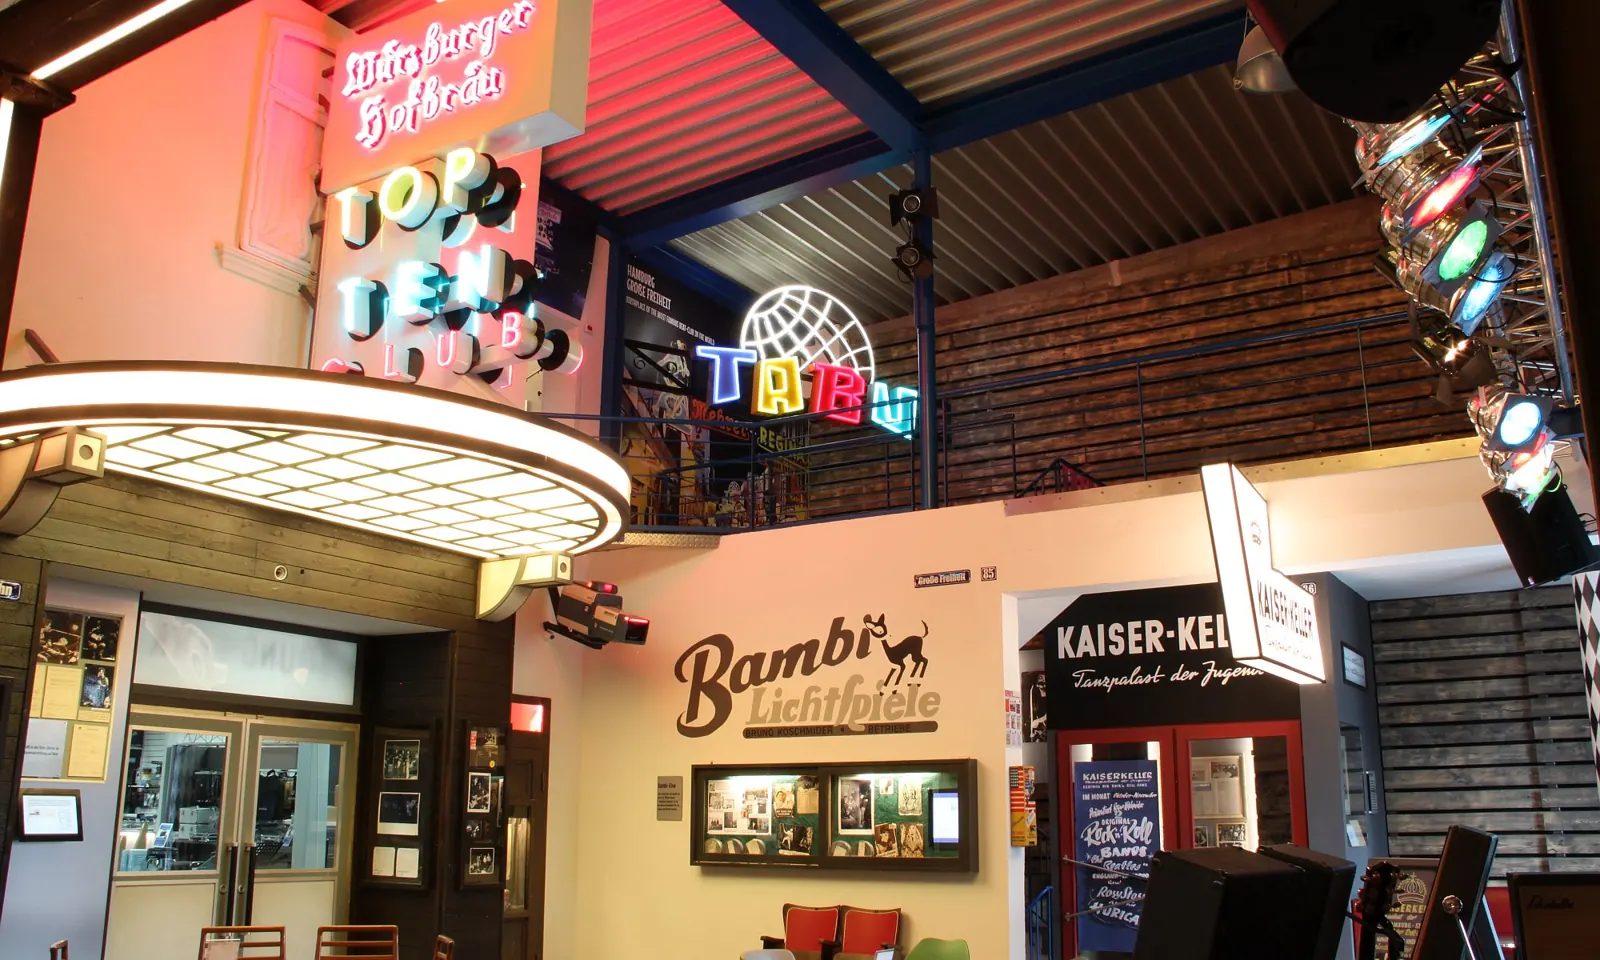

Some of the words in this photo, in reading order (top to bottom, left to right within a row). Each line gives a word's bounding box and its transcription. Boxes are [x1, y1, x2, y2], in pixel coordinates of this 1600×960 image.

[335, 146, 478, 247] TOP
[627, 264, 656, 289] HAMBURG
[337, 244, 494, 342] TEN
[646, 288, 672, 311] FREIHEIT
[695, 345, 919, 440] TABU
[939, 572, 966, 584] Freiheit
[982, 568, 995, 580] 85
[1257, 579, 1314, 642] KAISER-KELLER
[1057, 614, 1229, 660] KAISER-KEL
[674, 616, 872, 738] Bambi
[1072, 665, 1165, 693] Tanzpalast
[1170, 663, 1199, 683] der
[746, 726, 774, 737] BRUNO
[777, 724, 834, 737] KOSCHMIDER
[868, 723, 911, 734] BETRIEBE
[1082, 771, 1153, 781] KAISERKELLER
[1101, 817, 1131, 826] ORIGINAL
[1100, 846, 1148, 859] BANDS
